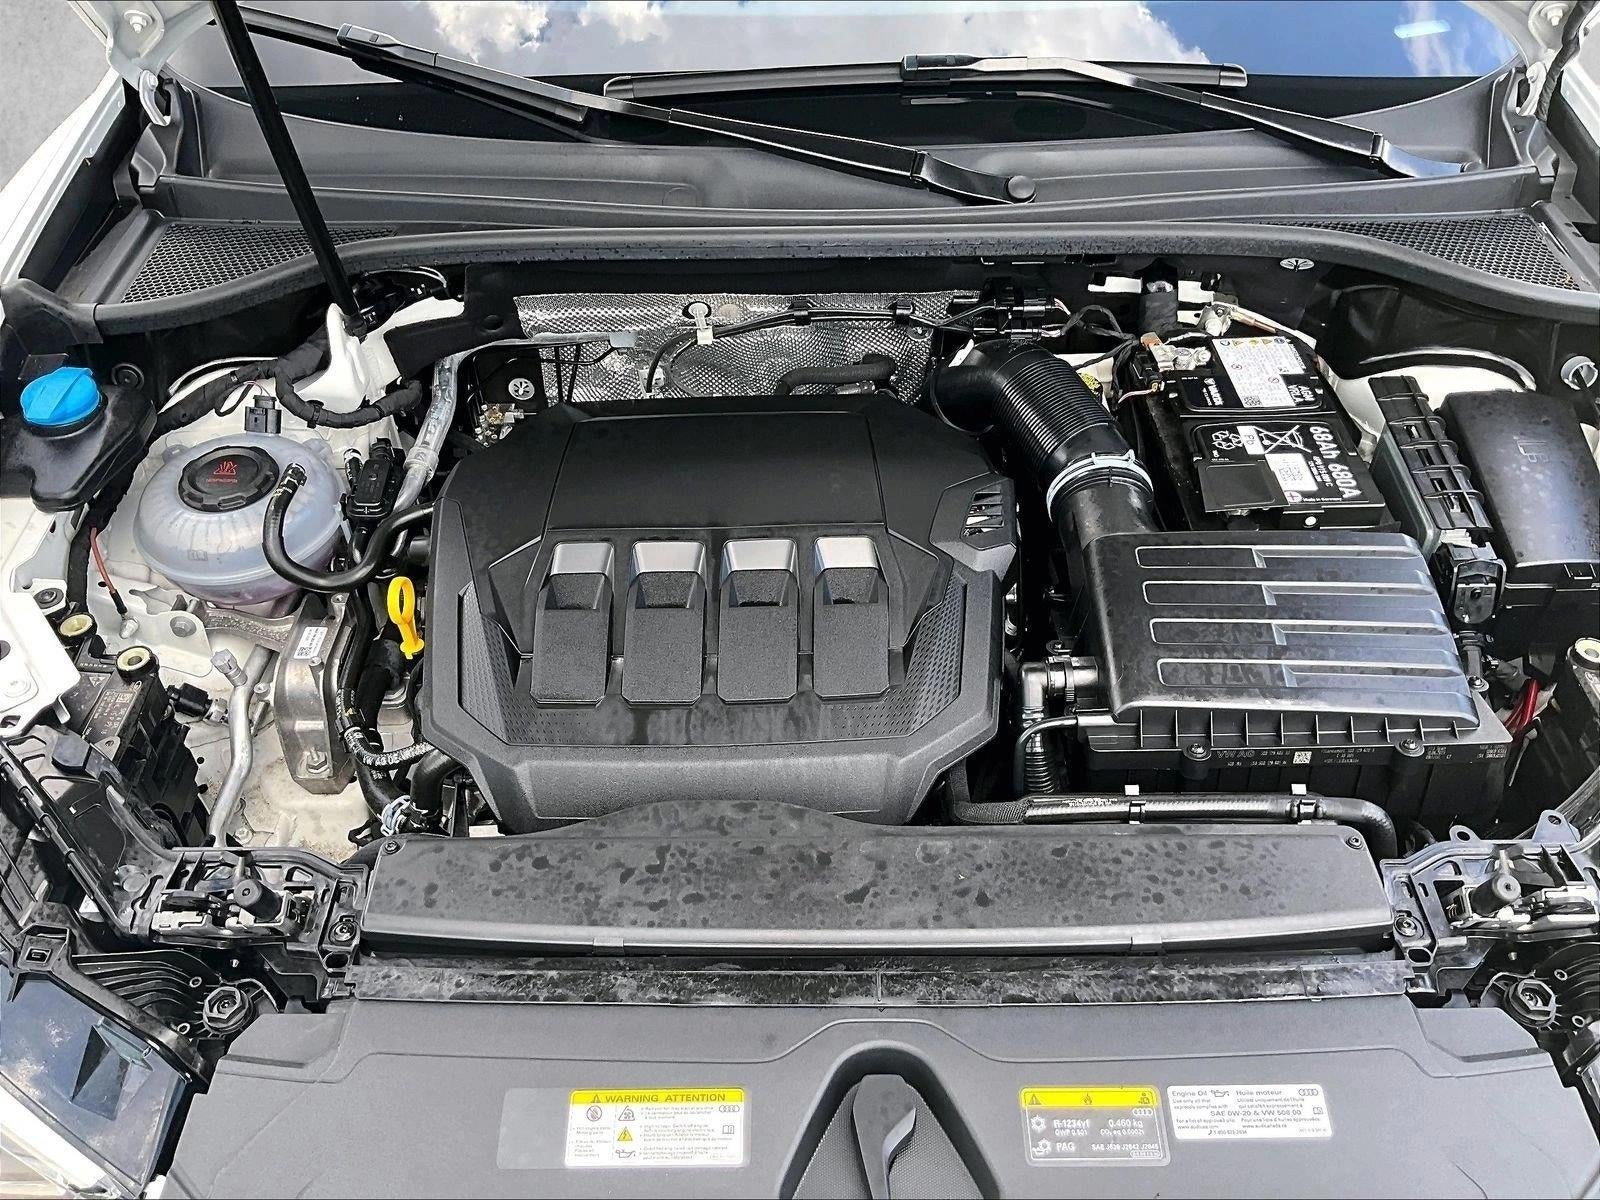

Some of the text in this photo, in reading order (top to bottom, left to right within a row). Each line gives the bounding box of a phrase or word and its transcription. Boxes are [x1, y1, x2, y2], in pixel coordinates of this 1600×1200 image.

[1287, 385, 1304, 405] VRLA
[1298, 385, 1316, 401] AGM
[1243, 434, 1254, 445] Pb
[1309, 426, 1341, 459] 68Ah
[1327, 463, 1362, 498] 680A
[605, 1093, 726, 1103] WARNING ATTENTION
[1053, 1118, 1090, 1128] R-1234yf
[1108, 1118, 1144, 1128] 0.460 kg
[1056, 1141, 1075, 1151] PAG
[1091, 1143, 1105, 1151] SAE
